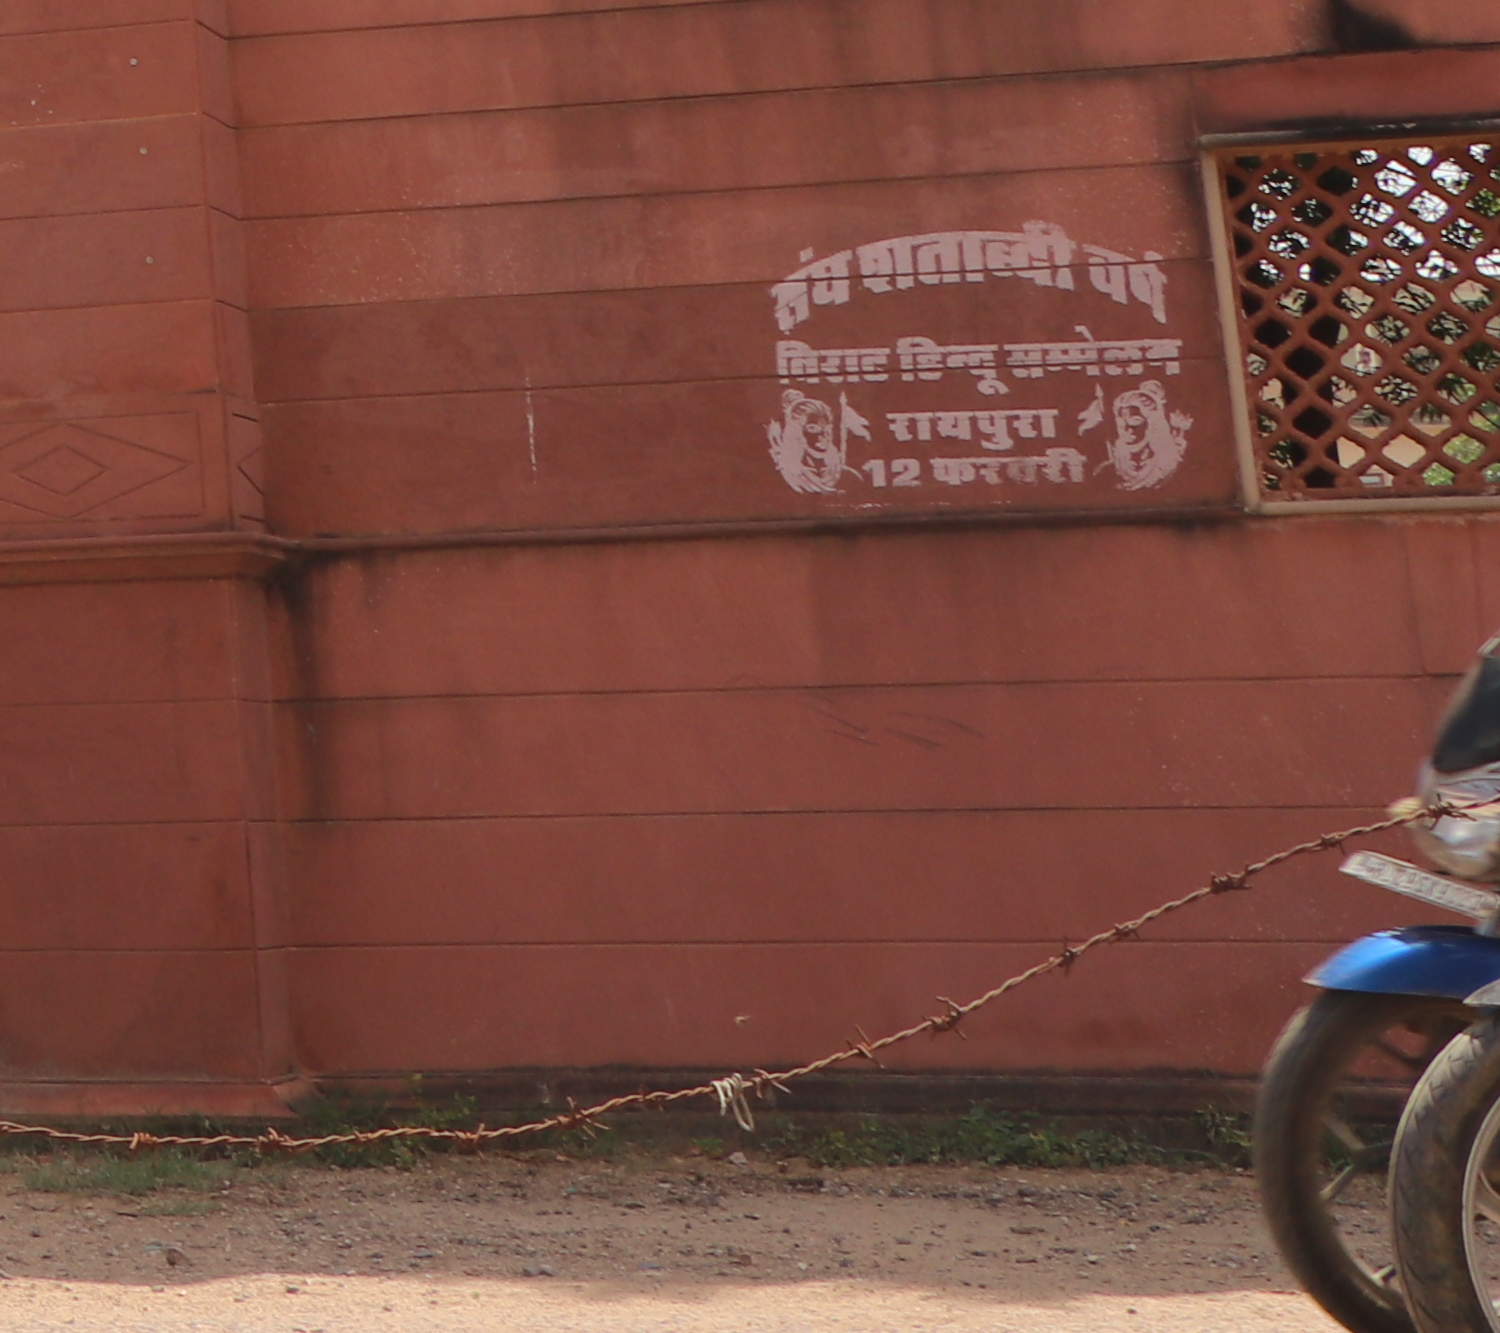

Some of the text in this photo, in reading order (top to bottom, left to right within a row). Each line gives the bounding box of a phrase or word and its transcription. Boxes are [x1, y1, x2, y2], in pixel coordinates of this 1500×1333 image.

[896, 336, 1010, 396] हिन्दू
[1003, 325, 1183, 379] सम्मेलन
[886, 408, 1059, 451] रायपुरा
[862, 458, 921, 488] 12
